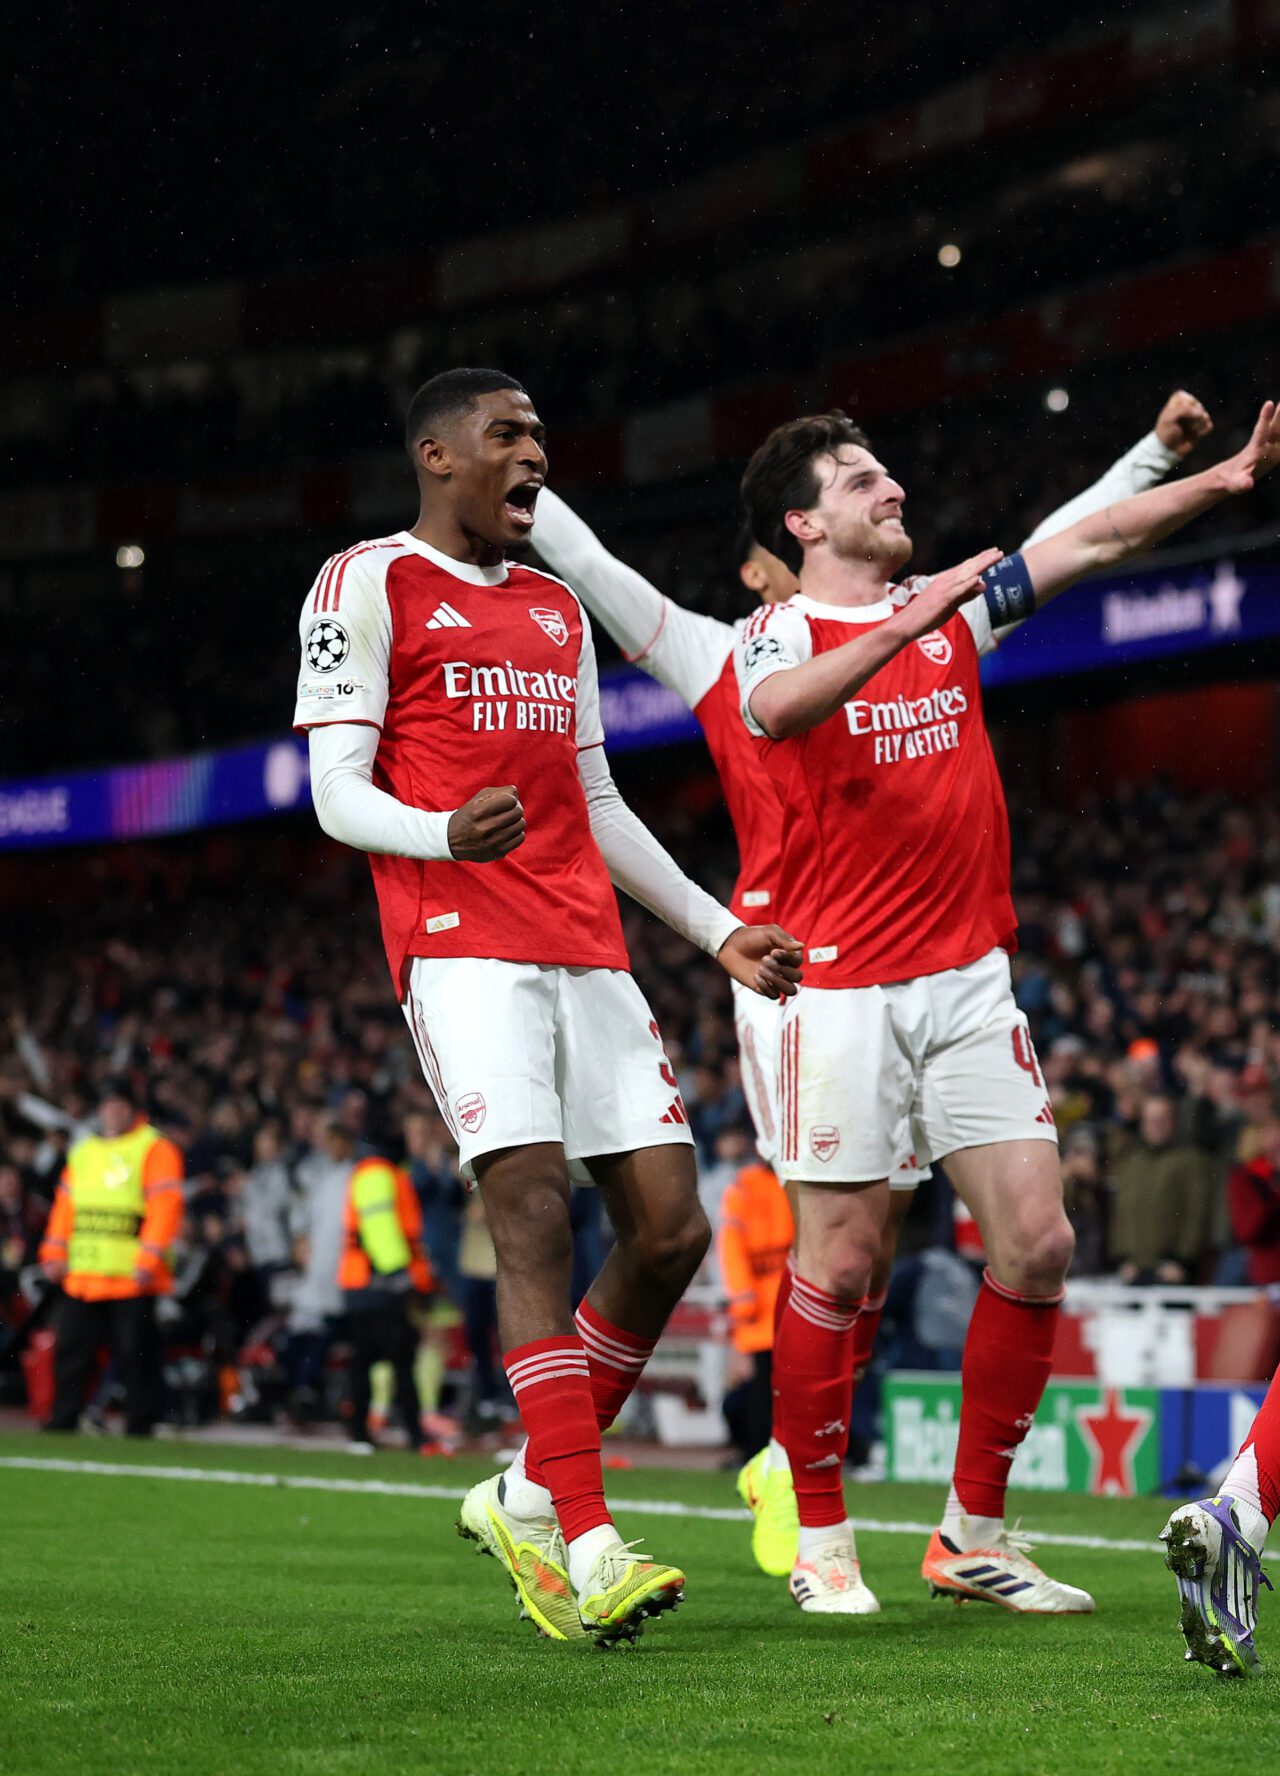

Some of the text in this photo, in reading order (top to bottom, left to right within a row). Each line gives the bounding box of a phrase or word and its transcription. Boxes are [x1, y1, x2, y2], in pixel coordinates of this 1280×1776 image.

[473, 701, 508, 731] FLY
[844, 686, 968, 736] Emirates
[874, 721, 959, 765] FLY BETTER
